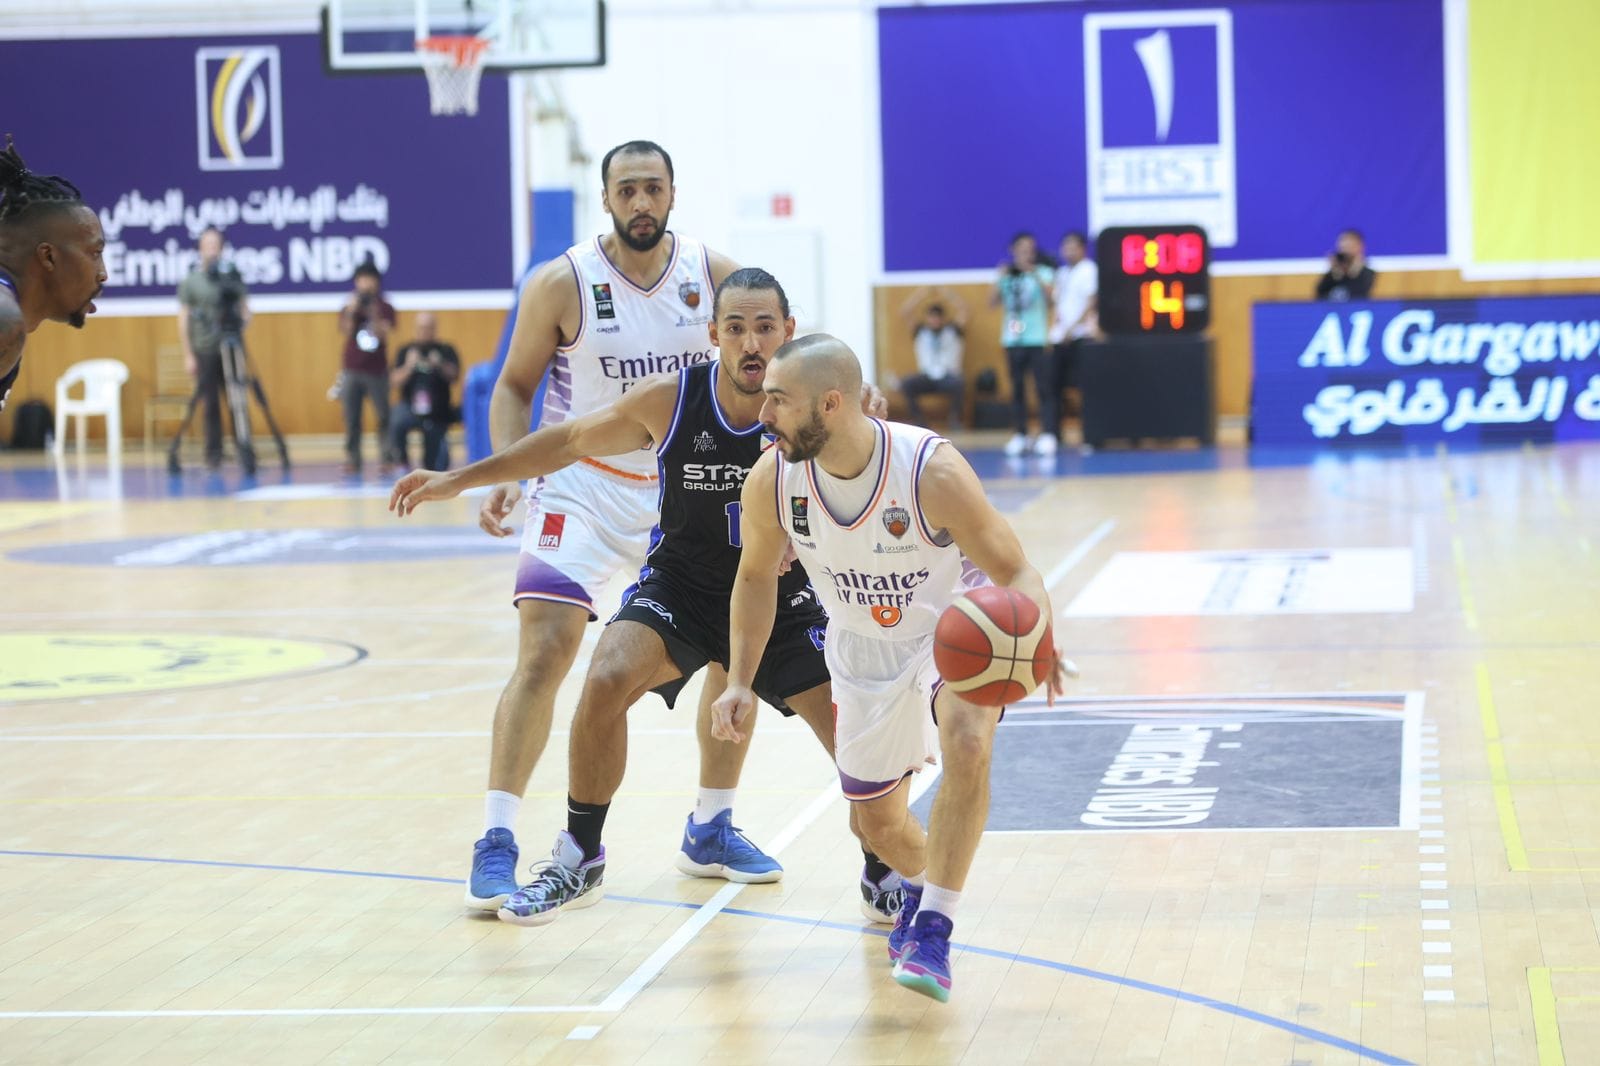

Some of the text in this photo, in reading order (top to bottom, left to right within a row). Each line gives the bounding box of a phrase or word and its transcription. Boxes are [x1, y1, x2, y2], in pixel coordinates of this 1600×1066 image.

[97, 235, 391, 287] Emirtes NBD
[1139, 280, 1184, 331] 14
[1297, 309, 1600, 376] Al Gargaw
[683, 481, 734, 491] GROUP
[540, 534, 559, 547] UFA
[856, 591, 914, 608] BETTER
